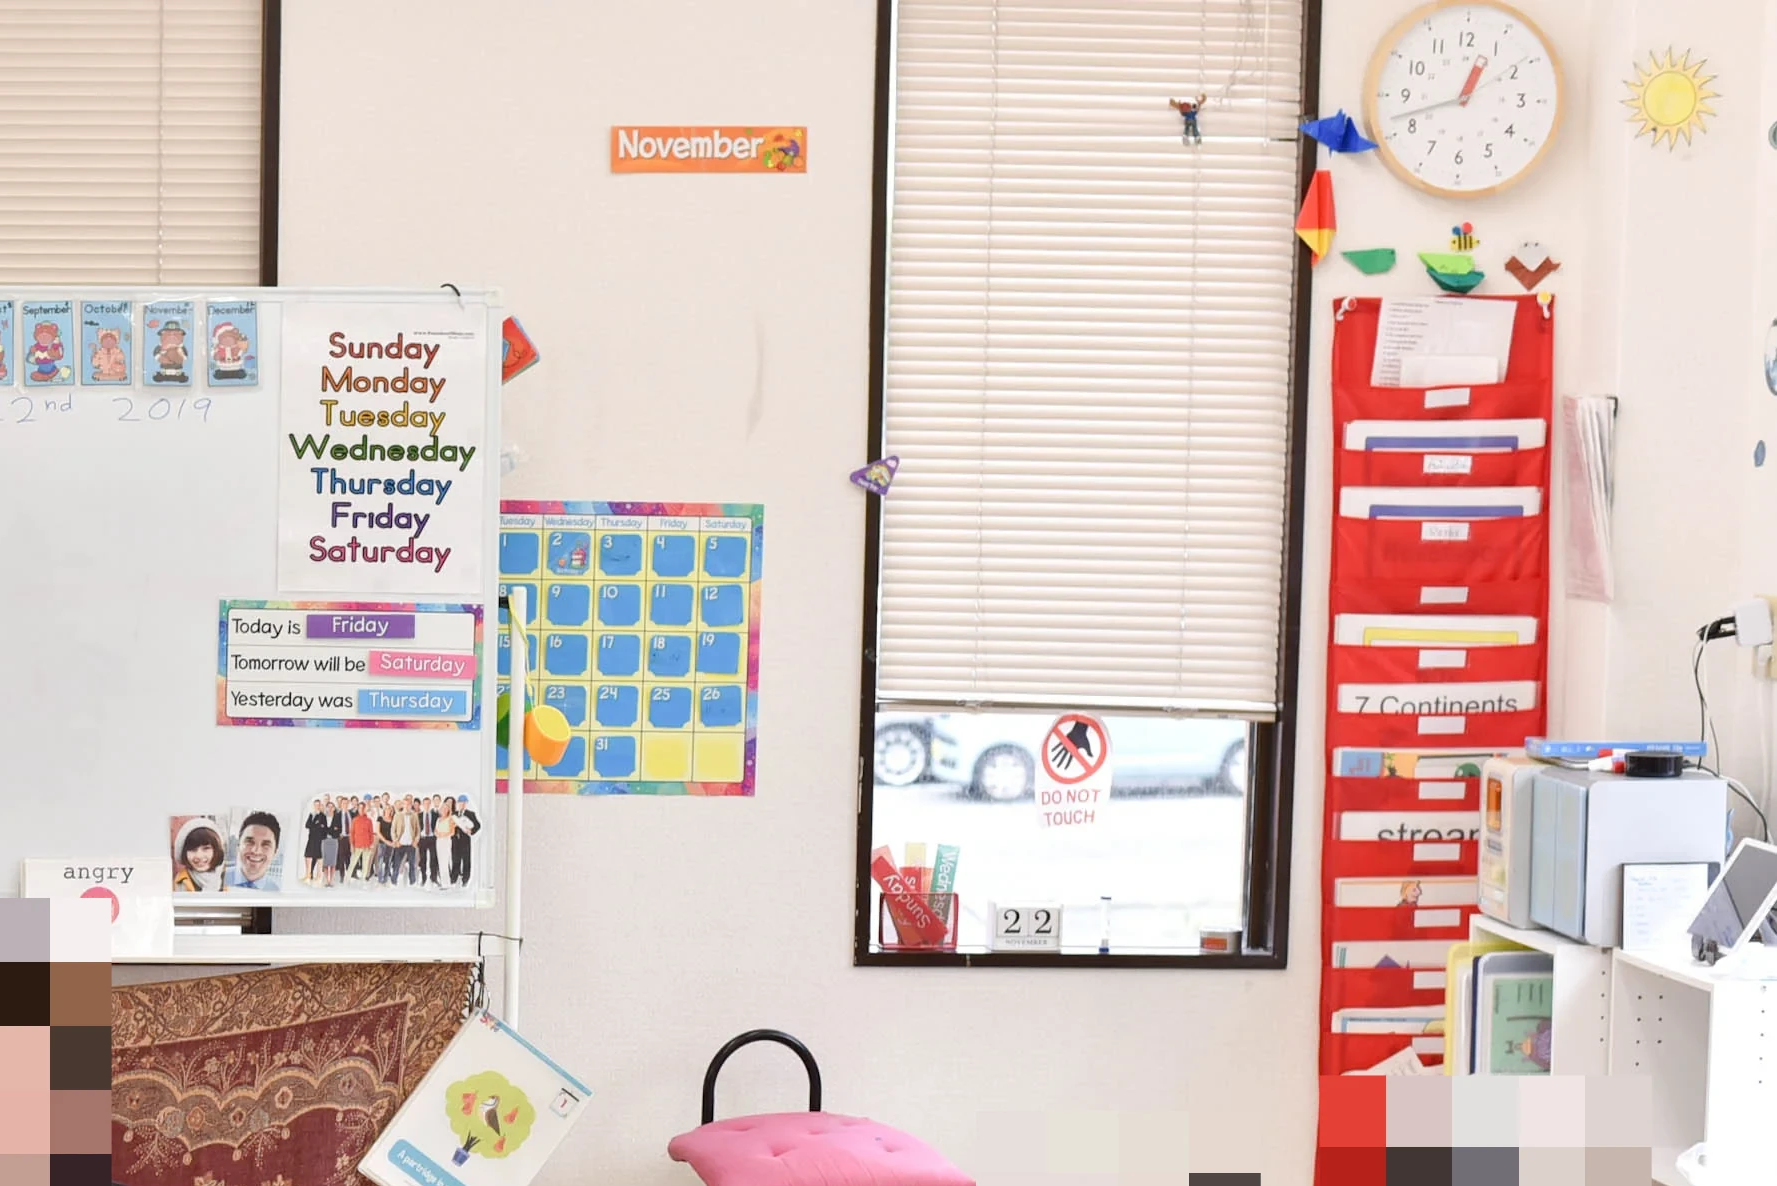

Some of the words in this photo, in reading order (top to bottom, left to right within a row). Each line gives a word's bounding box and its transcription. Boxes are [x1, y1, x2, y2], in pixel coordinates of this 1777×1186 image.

[1433, 39, 1443, 54] 11
[1459, 32, 1474, 47] 12
[1410, 60, 1424, 76] 10
[1511, 65, 1518, 80] 2
[1401, 88, 1410, 103] 9
[1517, 93, 1525, 108] 3
[1408, 118, 1417, 134] 8
[1504, 124, 1515, 138] 4
[618, 129, 764, 159] November
[1427, 141, 1436, 155] 7
[1484, 143, 1493, 158] 5
[1455, 151, 1463, 165] 6
[23, 305, 71, 317] September
[84, 304, 127, 314] October
[207, 304, 255, 315] December
[329, 332, 440, 369] Sunday
[321, 366, 446, 403] Monday
[112, 397, 212, 423] 2019
[320, 400, 446, 437] Tuesday
[289, 434, 475, 471] Wednesday
[311, 468, 452, 505] Thursday
[331, 502, 430, 538] Friday
[499, 517, 536, 528] Tuesday
[545, 518, 593, 528] Wednesday
[601, 519, 643, 529] Thursday
[660, 519, 687, 529] Friday
[705, 520, 747, 530] Saturday
[552, 533, 562, 545] 2
[604, 536, 613, 548] 3
[656, 537, 664, 548] 4
[709, 537, 717, 549] 5
[309, 536, 451, 573] Saturday
[499, 585, 507, 597] 8
[552, 586, 561, 598] 9
[603, 587, 618, 598] 10
[656, 585, 665, 598] 11
[705, 587, 718, 599] 12
[232, 618, 283, 638] Today
[288, 620, 301, 635] is
[332, 616, 389, 636] Friday
[499, 636, 510, 648] 15
[549, 636, 562, 648] 16
[602, 636, 614, 648] 17
[653, 636, 665, 649] 18
[702, 633, 714, 646] 19
[231, 654, 309, 671] Tomorrow
[314, 656, 340, 672] will
[345, 657, 366, 673] be
[380, 653, 465, 676] Saturday
[547, 687, 565, 699] 23
[599, 687, 618, 700] 24
[653, 687, 670, 700] 25
[703, 687, 720, 700] 26
[231, 690, 313, 711] Yesterday
[318, 696, 353, 708] was
[369, 691, 453, 712] Thursday
[1355, 696, 1370, 713] 7
[1380, 694, 1517, 716] Continents
[596, 737, 608, 750] 31
[1041, 790, 1062, 805] DO
[1067, 789, 1101, 804] NOT
[1043, 809, 1095, 827] TOUCH
[63, 864, 134, 884] angry
[883, 874, 931, 928] Sunday
[1005, 938, 1048, 946] NOVEMBER
[397, 1150, 406, 1159] A
[402, 1156, 437, 1184] partridge
